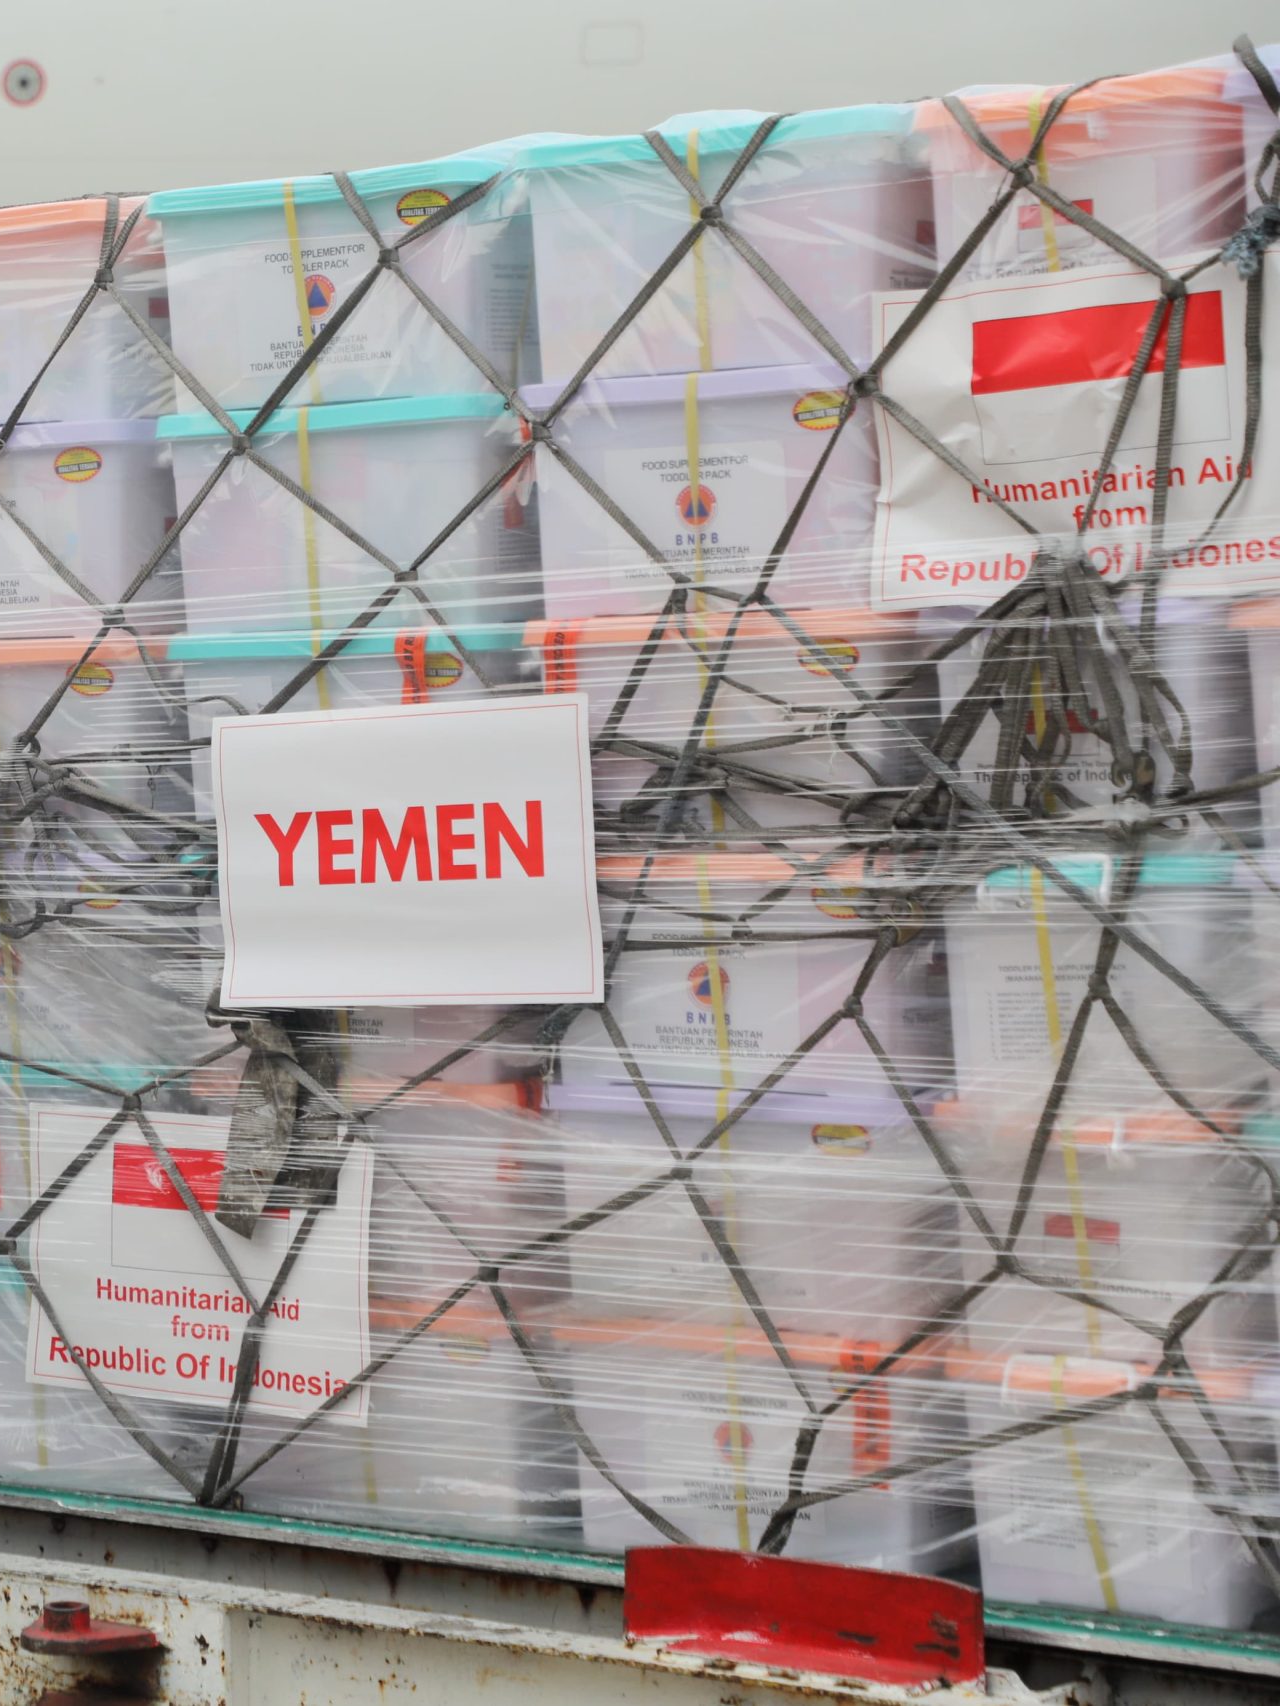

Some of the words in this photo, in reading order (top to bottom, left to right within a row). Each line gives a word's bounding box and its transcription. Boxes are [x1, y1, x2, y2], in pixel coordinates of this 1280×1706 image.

[264, 253, 288, 263] FOOD
[290, 245, 346, 260] PPLEMENT
[347, 243, 365, 253] FOR
[282, 260, 323, 275] TOLER
[324, 258, 349, 270] PACK
[270, 340, 306, 351] BANTUA
[274, 349, 307, 360] REPUB
[250, 362, 274, 372] TIDAK
[276, 361, 299, 370] UNTU
[642, 461, 667, 471] FOOD
[669, 457, 728, 470] SUPEMENT
[729, 455, 749, 466] FOR
[1198, 455, 1254, 486] Aid
[660, 471, 704, 483] TODDLR
[705, 469, 732, 480] PACK
[1072, 502, 1147, 532] from
[675, 532, 719, 546] BNPB
[690, 545, 750, 556] PMERINTAH
[900, 551, 1038, 587] Republ
[1090, 543, 1126, 577] Of
[253, 800, 545, 887] YEMEN
[686, 1012, 731, 1026] BNB
[656, 1025, 699, 1036] BANTUAN
[701, 1027, 763, 1040] PERINTAH
[659, 1035, 705, 1046] REPUBLIK
[707, 1036, 760, 1050] INNESIA
[269, 1297, 300, 1321] Aid
[171, 1315, 230, 1342] from
[49, 1336, 167, 1376] Republic
[175, 1352, 211, 1381] Of
